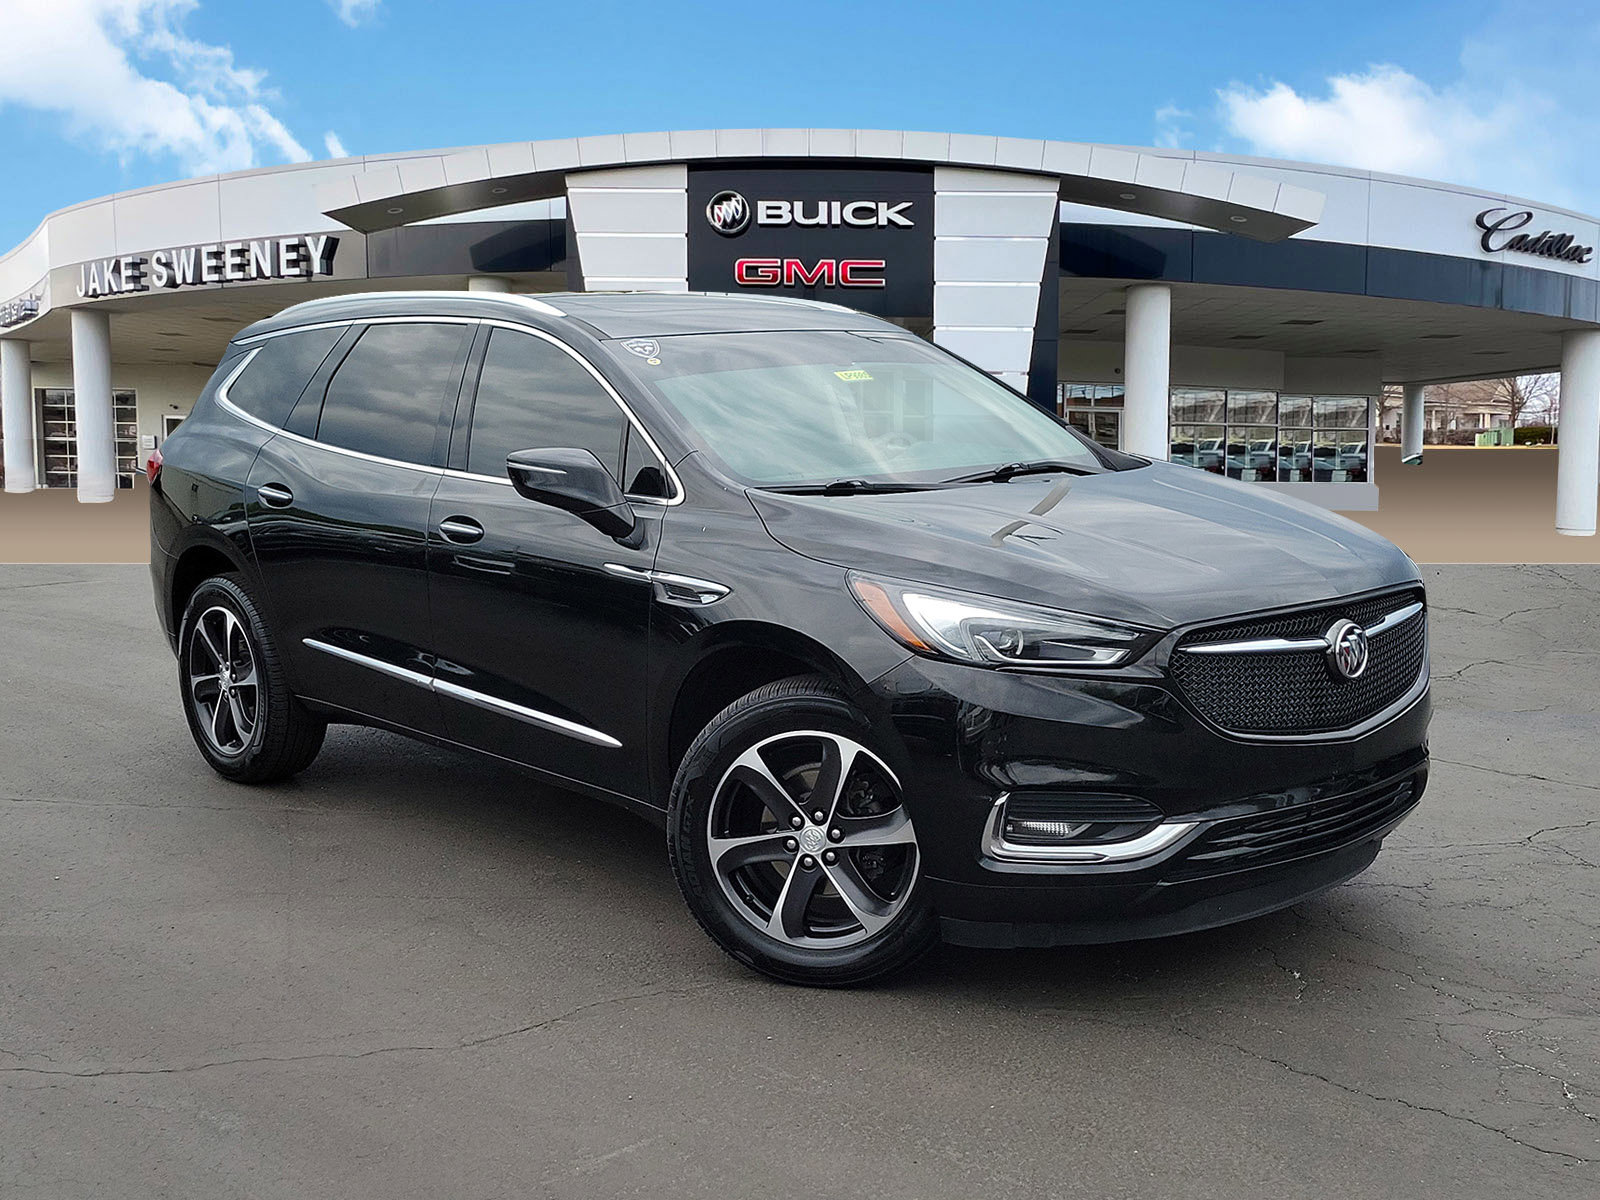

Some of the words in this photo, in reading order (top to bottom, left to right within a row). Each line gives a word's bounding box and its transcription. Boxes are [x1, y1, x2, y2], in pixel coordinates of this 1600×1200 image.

[757, 200, 915, 226] BUICK
[1475, 207, 1594, 264] Cadillac
[76, 256, 138, 298] JAKE
[151, 235, 332, 288] SWEENEY
[735, 258, 886, 287] GMC
